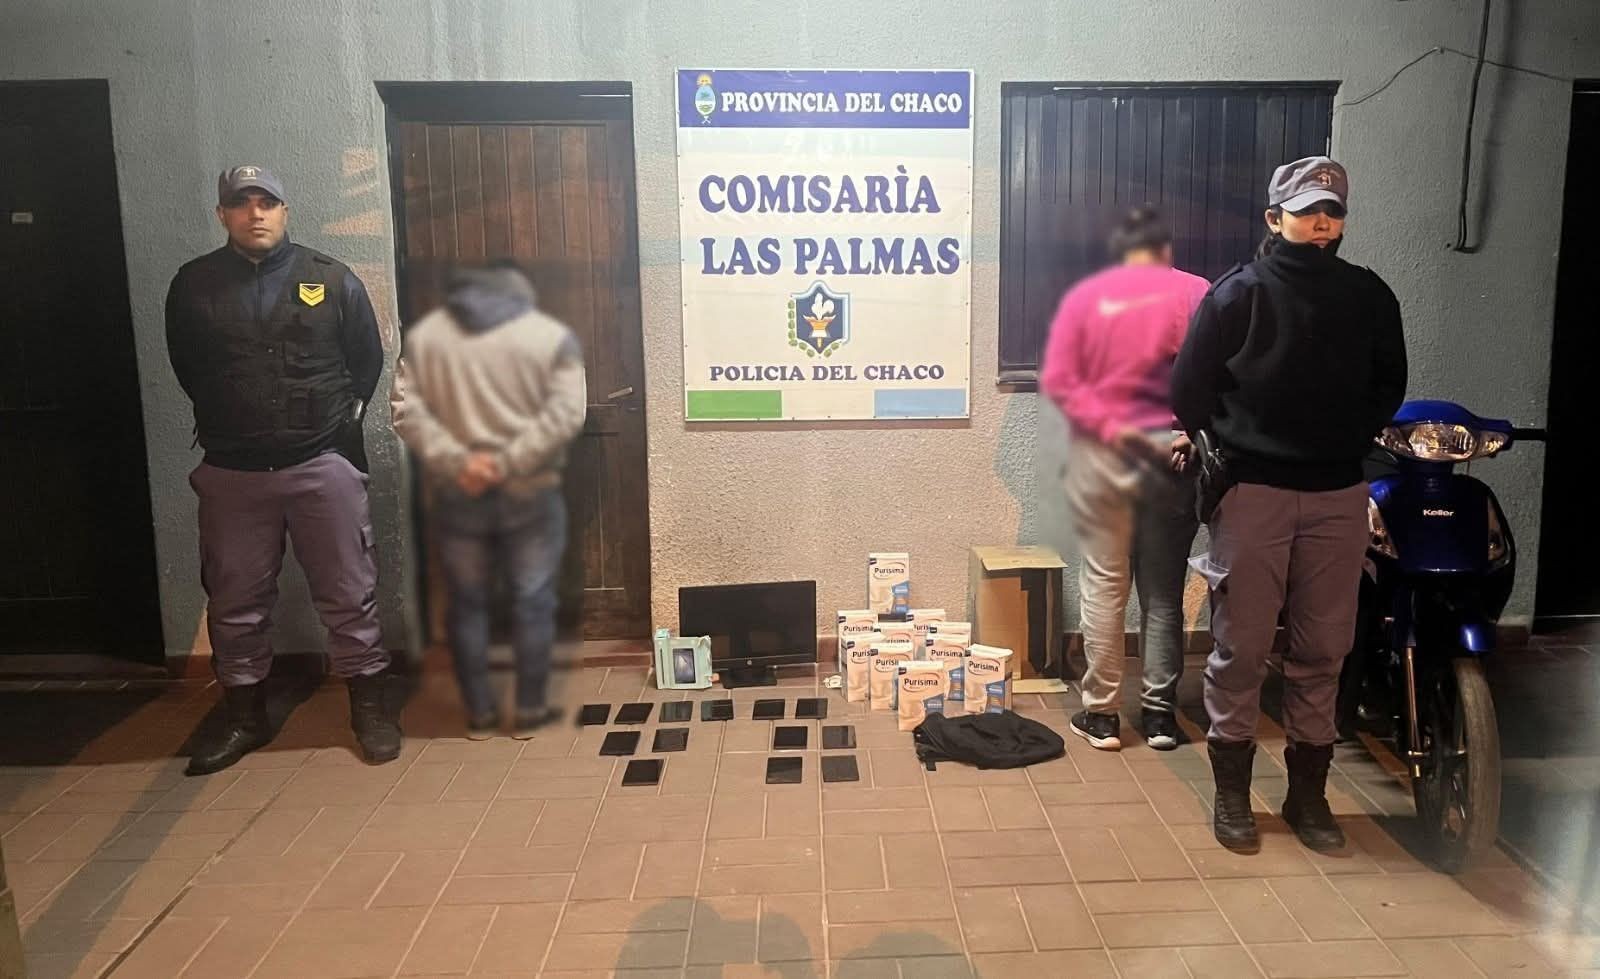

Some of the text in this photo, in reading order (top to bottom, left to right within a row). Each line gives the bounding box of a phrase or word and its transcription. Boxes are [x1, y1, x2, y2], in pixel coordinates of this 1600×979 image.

[721, 92, 962, 113] PROVINCIA DEL CHACO
[700, 237, 960, 275] LAS PALMAS
[709, 364, 945, 381] POLICIA DEL CHACO
[1423, 508, 1454, 517] Keller
